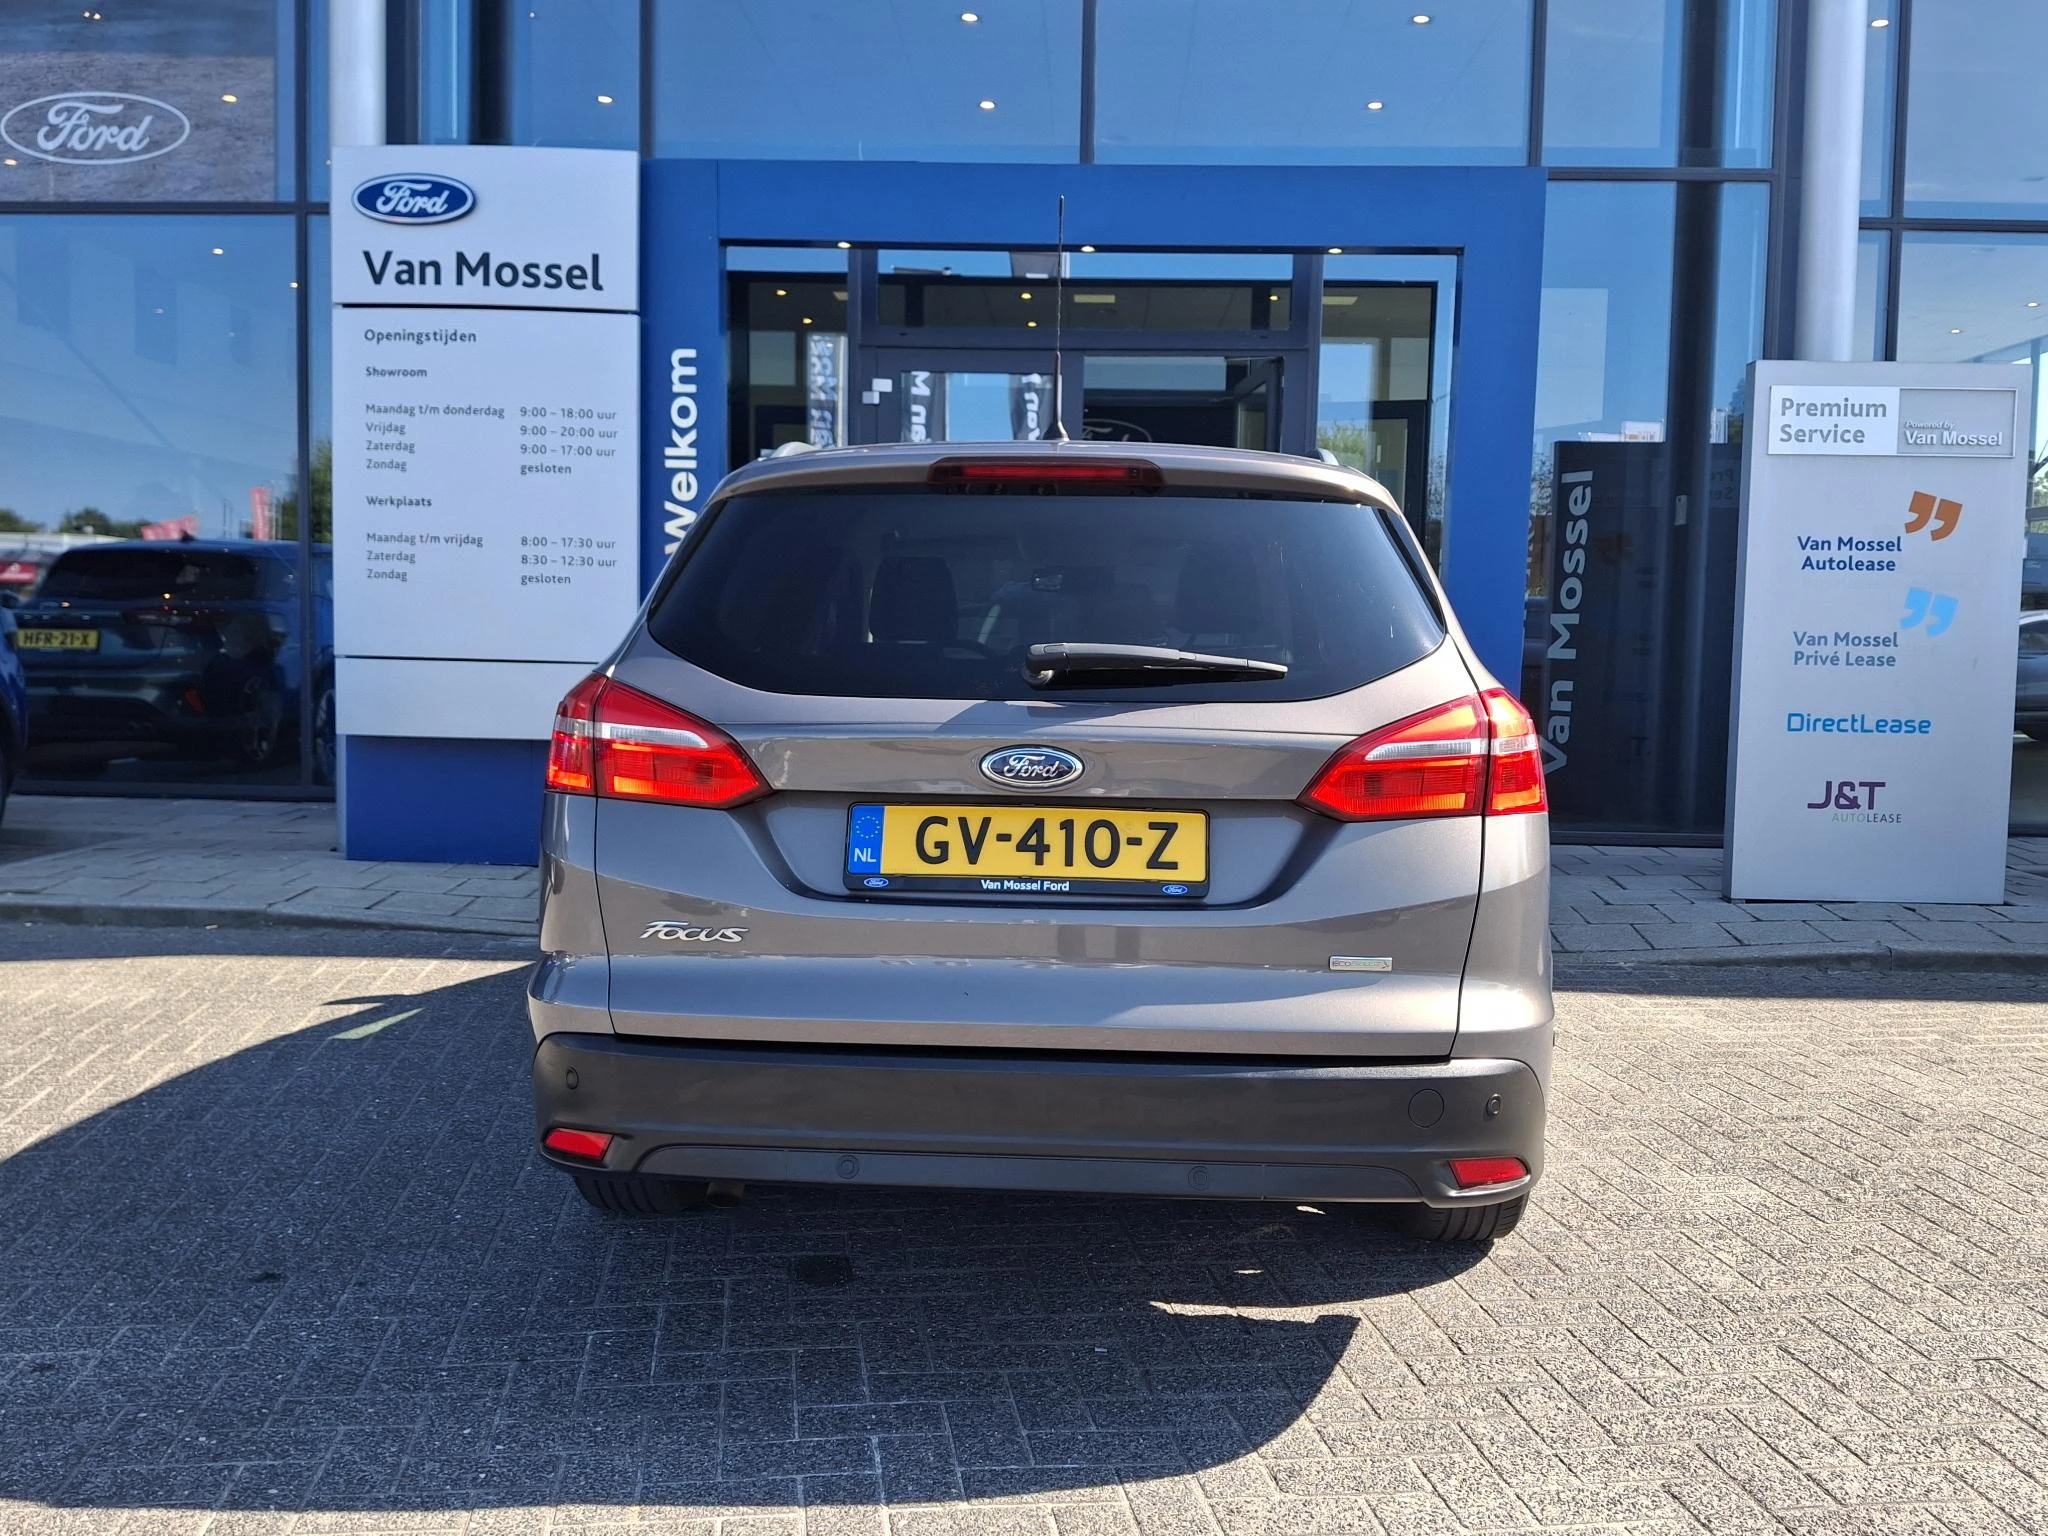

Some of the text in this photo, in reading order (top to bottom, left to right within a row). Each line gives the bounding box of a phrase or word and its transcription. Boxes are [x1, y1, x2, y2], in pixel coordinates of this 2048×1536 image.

[37, 101, 152, 153] Ford
[376, 181, 448, 215] Ford
[363, 251, 605, 292] Van Mossel
[364, 328, 477, 346] Openingstijden
[365, 366, 428, 378] Showroom
[365, 404, 506, 419] Maandag t/m donderdag
[520, 406, 547, 418] 9:00
[561, 408, 594, 420] 18:00
[597, 410, 618, 420] uur
[1780, 397, 1888, 418] Premium
[365, 422, 407, 436] Vrijdag
[520, 426, 547, 437] 9:00
[560, 427, 595, 438] 20:00
[598, 429, 618, 439] uur
[1905, 420, 1956, 431] Powered by
[1779, 423, 1866, 444] Service
[1905, 430, 2003, 447] Van Mossel
[365, 440, 415, 454] Zaterdag
[520, 444, 547, 455] 9:00
[561, 446, 593, 457] 17:00
[596, 448, 616, 457] uur
[664, 348, 699, 556] Welkom
[366, 459, 408, 473] Zondag
[520, 463, 572, 475] gesloten
[366, 496, 433, 509] Werkplaats
[366, 532, 484, 549] Maandag t/m vrijdag
[520, 536, 548, 547] 8:00
[561, 537, 593, 549] 17:30
[596, 540, 616, 549] uur
[1798, 536, 1903, 552] Van Mossel
[367, 551, 416, 564] Zaterdag
[521, 554, 548, 566] 8:30
[561, 556, 594, 567] 12:30
[597, 558, 618, 568] uur
[1801, 556, 1896, 572] Autolease
[367, 568, 408, 582] Zondag
[520, 572, 572, 585] gesloten
[1537, 470, 1594, 775] Van Mossel
[1793, 631, 1899, 648] Van Mossel
[1793, 650, 1897, 668] Privé Lease
[1787, 713, 1932, 735] DirectLease
[1003, 755, 1060, 779] Ford
[1807, 780, 1887, 811] J&T
[1831, 813, 1903, 824] AUTOLEASE
[914, 815, 1179, 871] GV-410-Z
[853, 847, 876, 863] NL
[869, 878, 886, 888] Ford
[981, 880, 1070, 892] Van Mossel Ford
[1166, 885, 1184, 895] Ford
[640, 920, 750, 942] Focus
